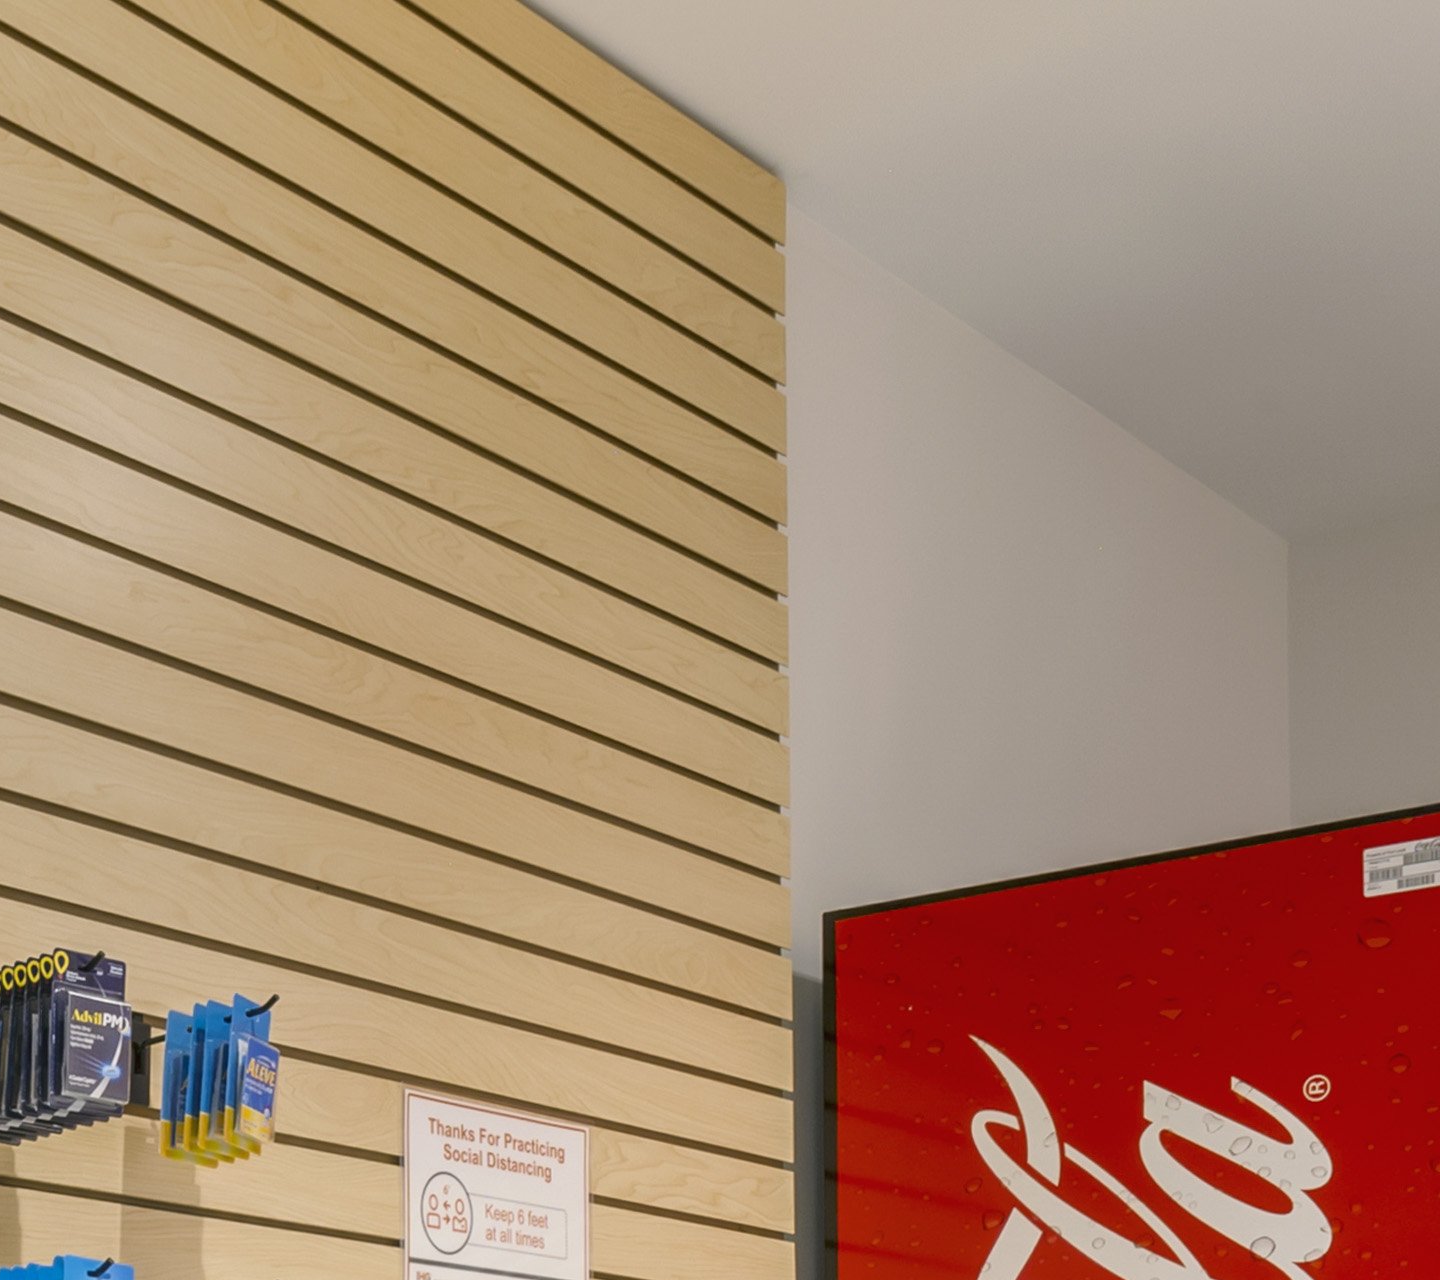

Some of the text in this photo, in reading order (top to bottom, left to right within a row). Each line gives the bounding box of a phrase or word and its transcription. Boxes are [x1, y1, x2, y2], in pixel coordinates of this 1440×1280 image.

[71, 1007, 129, 1033] Advil PM
[246, 1057, 276, 1089] ALEVE
[428, 1117, 565, 1164] Thanks For Practicing
[443, 1144, 552, 1183] Social Distancing
[485, 1204, 549, 1229] Keep 6 feet
[486, 1229, 545, 1250] at all times
